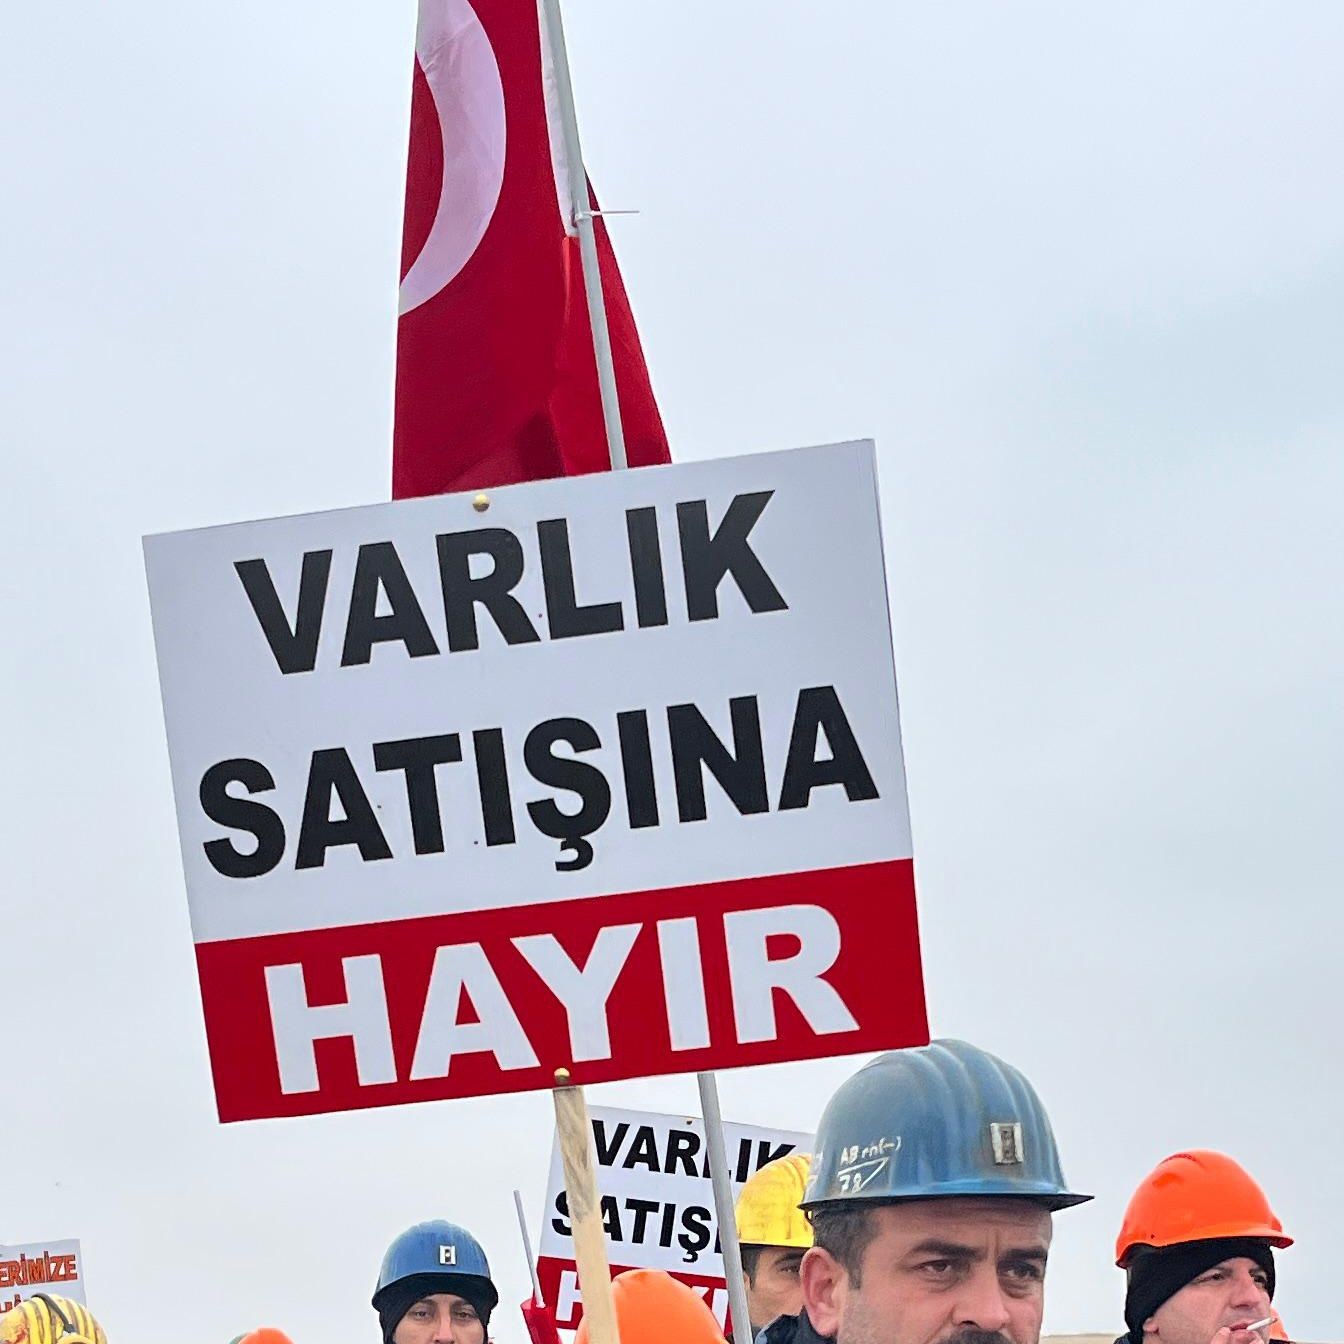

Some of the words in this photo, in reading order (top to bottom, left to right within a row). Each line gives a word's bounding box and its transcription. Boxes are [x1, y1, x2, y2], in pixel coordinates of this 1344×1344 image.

[233, 489, 789, 675] VARLIK
[198, 685, 880, 878] SATIŞINA
[263, 903, 861, 1096] HAYIR
[551, 1190, 723, 1263] SATIŞ
[840, 1145, 859, 1165] AB
